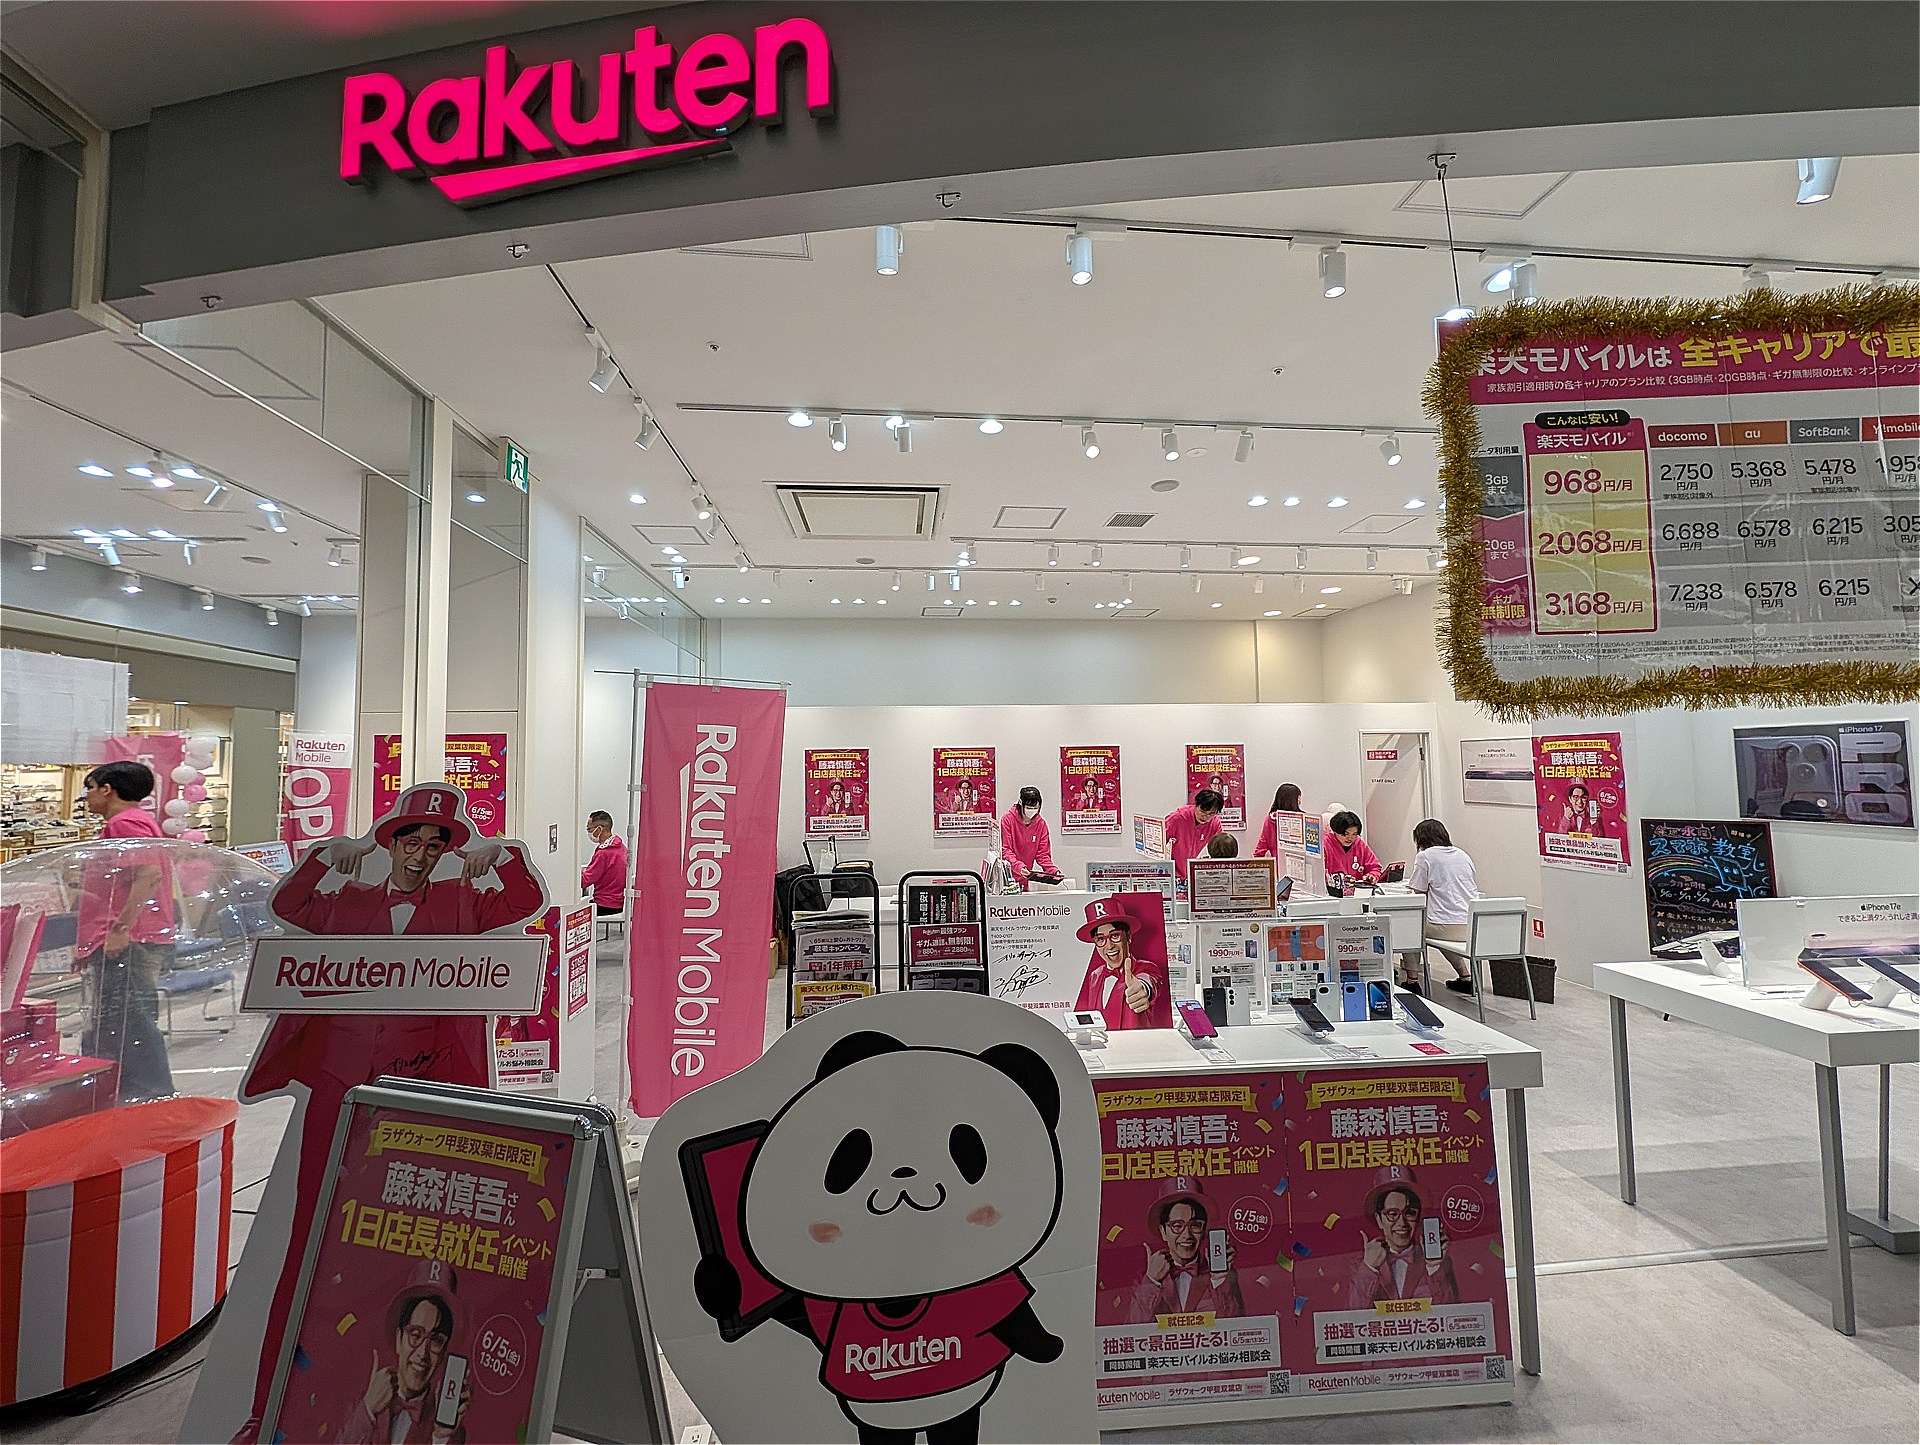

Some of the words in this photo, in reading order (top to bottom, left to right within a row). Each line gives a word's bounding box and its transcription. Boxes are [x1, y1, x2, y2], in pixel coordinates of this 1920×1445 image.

[341, 17, 830, 196] Rakuten
[1658, 431, 1708, 442] docomo
[1745, 429, 1761, 439] au
[1798, 426, 1851, 437] SoftBank
[1537, 432, 1627, 449] 楽天モバイル
[1660, 462, 1713, 481] 2,750
[1485, 474, 1509, 485] 3GB
[1676, 481, 1698, 491] 円/月
[1749, 478, 1772, 488] 円/月
[1822, 476, 1844, 485] 円/月
[1487, 486, 1507, 495] まで
[1662, 522, 1719, 541] 6,688
[1737, 519, 1791, 538] 6,578
[1812, 517, 1863, 535] 6,215
[1680, 541, 1702, 550] 円/月
[1754, 538, 1777, 548] 円/月
[1826, 536, 1849, 545] 円/月
[1490, 551, 1509, 560] まで
[1669, 583, 1723, 601] 7,238
[1744, 581, 1798, 598] 6,578
[1818, 578, 1870, 596] 6,215
[1493, 595, 1512, 604] ギガ
[1685, 602, 1708, 611] 円/月
[1761, 599, 1784, 608] 円/月
[1834, 597, 1857, 606] 円/月
[1481, 605, 1526, 619] 無制限
[296, 739, 345, 751] Rakuten
[295, 752, 331, 763] Mobile
[1539, 766, 1599, 778] 1日店長就任
[428, 793, 443, 814] R
[680, 724, 738, 918] Rakuten
[990, 906, 1036, 919] Rakuten
[1036, 905, 1071, 916] Mobile
[1094, 902, 1108, 918] R
[275, 954, 407, 995] Rakuten
[410, 956, 511, 988] Mobile
[670, 928, 723, 1077] Mobile
[1316, 1081, 1455, 1098] ラザウォーク甲斐双葉店限定!
[1102, 1090, 1247, 1108] ラザウォーク甲斐双葉店限定!
[381, 1126, 537, 1168] ラザウォーク甲斐双葉店限定!
[1443, 1134, 1485, 1149] イベント
[1232, 1144, 1276, 1159] イベント
[1298, 1137, 1443, 1171] 1日店長就任
[1445, 1149, 1470, 1164] 開催
[1234, 1160, 1259, 1175] 開催
[1390, 1165, 1401, 1180] R
[1177, 1176, 1188, 1190] R
[339, 1198, 500, 1274] 1日店長就任
[502, 1233, 552, 1261] イベント
[429, 1260, 442, 1281] R
[497, 1254, 529, 1281] 開催
[1385, 1302, 1422, 1313] 就任記念
[1167, 1315, 1205, 1327] 就任記念
[1323, 1317, 1446, 1341] 抽選で景品当たる!
[1103, 1330, 1229, 1356] 抽選で景品当たる!
[1367, 1336, 1487, 1354] 楽天モバイルお悩み相談会
[845, 1335, 962, 1378] Rakuten
[1147, 1349, 1271, 1369] 楽天モバイルお悩み相談会
[1308, 1376, 1350, 1391] Rakuten
[1350, 1374, 1381, 1385] Mobile
[1098, 1392, 1128, 1406] kuten
